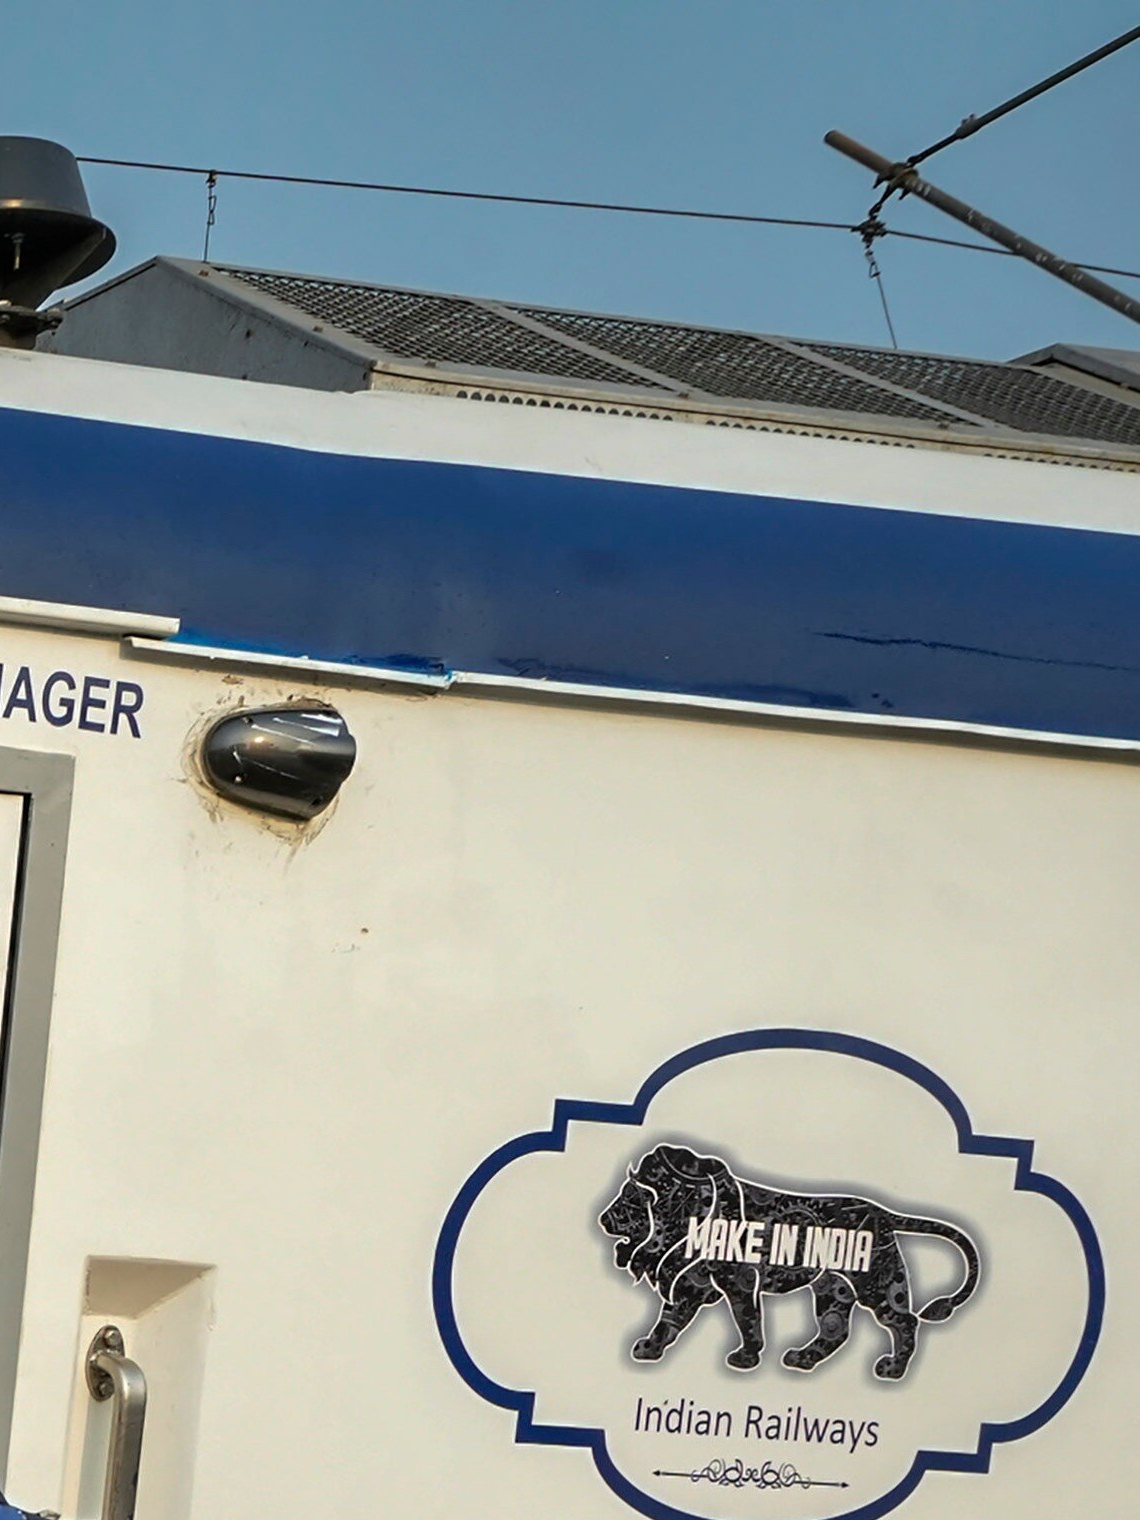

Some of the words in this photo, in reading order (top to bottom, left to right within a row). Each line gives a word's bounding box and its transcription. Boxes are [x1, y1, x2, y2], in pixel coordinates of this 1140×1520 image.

[685, 1216, 765, 1264] MAKE
[769, 1223, 799, 1266] IN
[803, 1226, 874, 1272] INDIA
[634, 1397, 732, 1437] Indian
[744, 1405, 880, 1454] Railways
